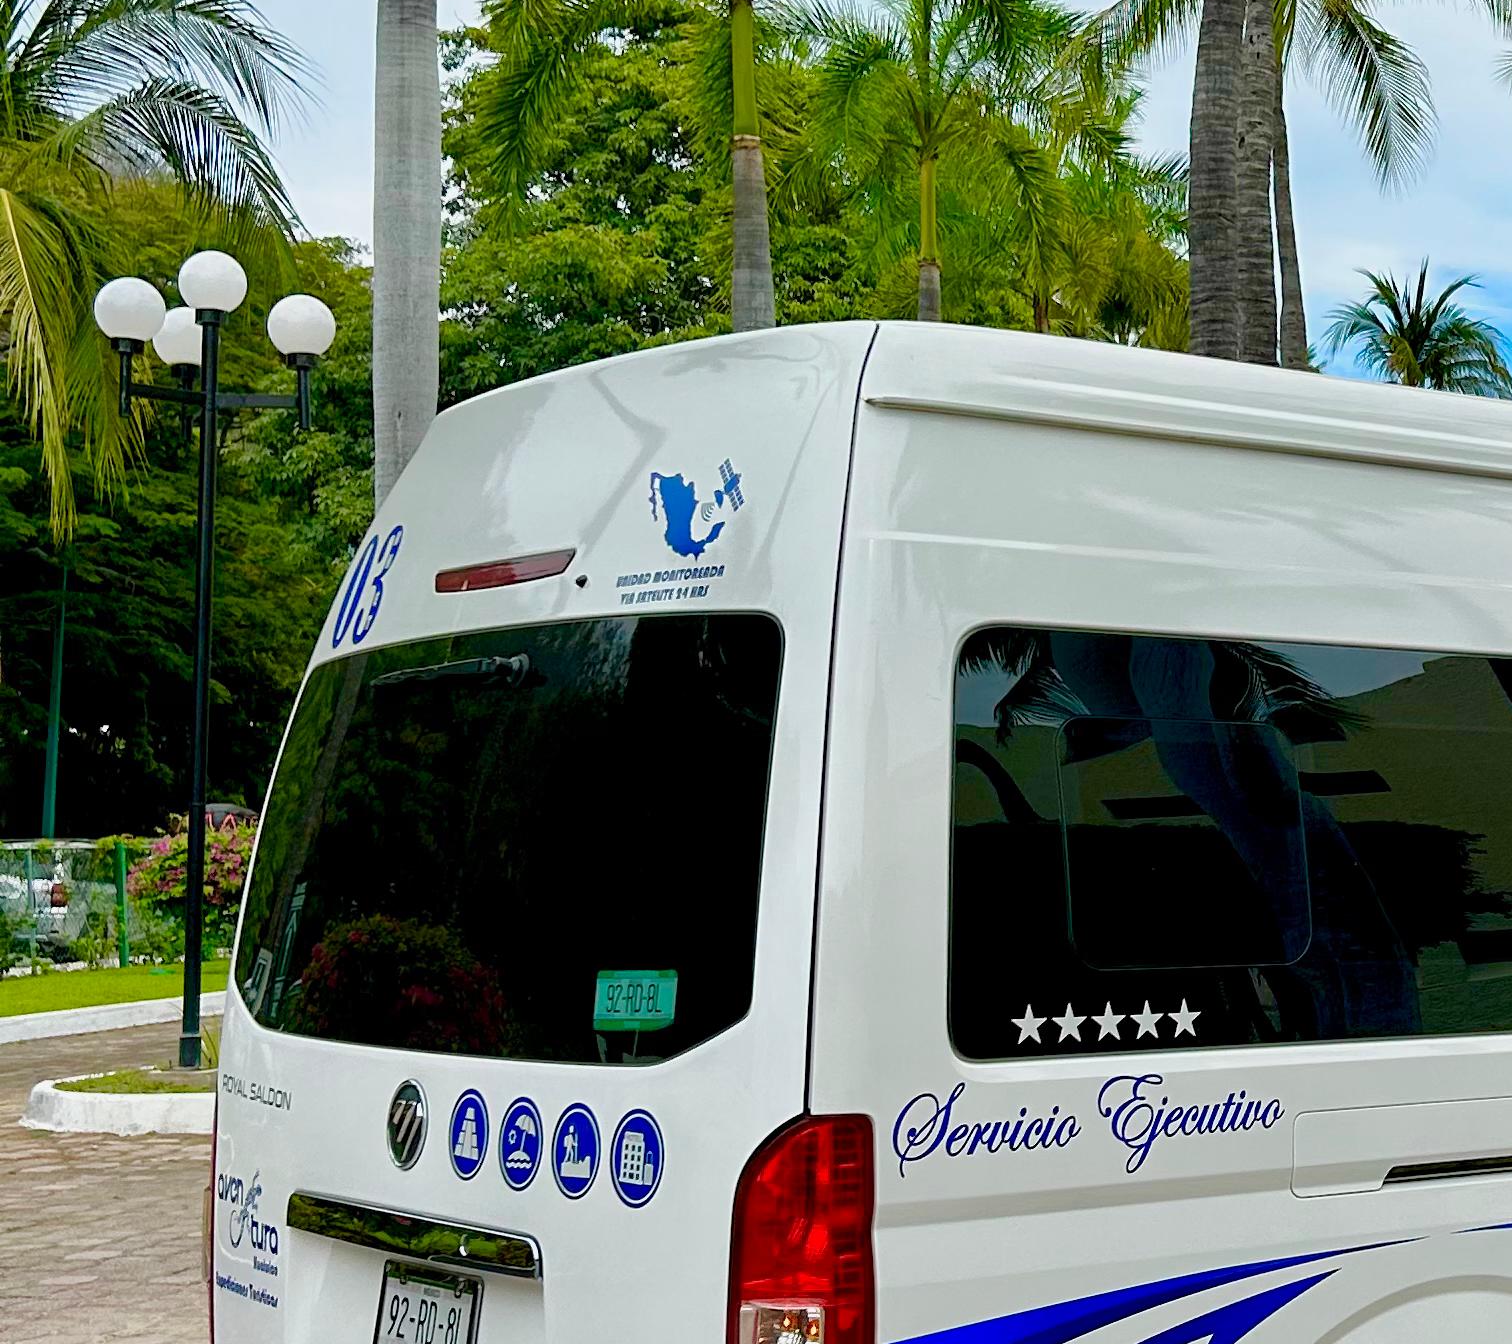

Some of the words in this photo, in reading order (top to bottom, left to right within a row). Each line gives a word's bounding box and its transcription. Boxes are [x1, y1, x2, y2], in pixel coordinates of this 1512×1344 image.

[332, 525, 404, 649] 03
[652, 565, 726, 584] MONITOREADA
[676, 586, 689, 600] 24
[606, 983, 663, 1013] 92-RD-8L
[222, 1073, 248, 1099] ROYAL
[892, 1082, 1083, 1178] Servicio
[1097, 1074, 1286, 1175] Ejecutivo
[250, 1214, 278, 1255] tura
